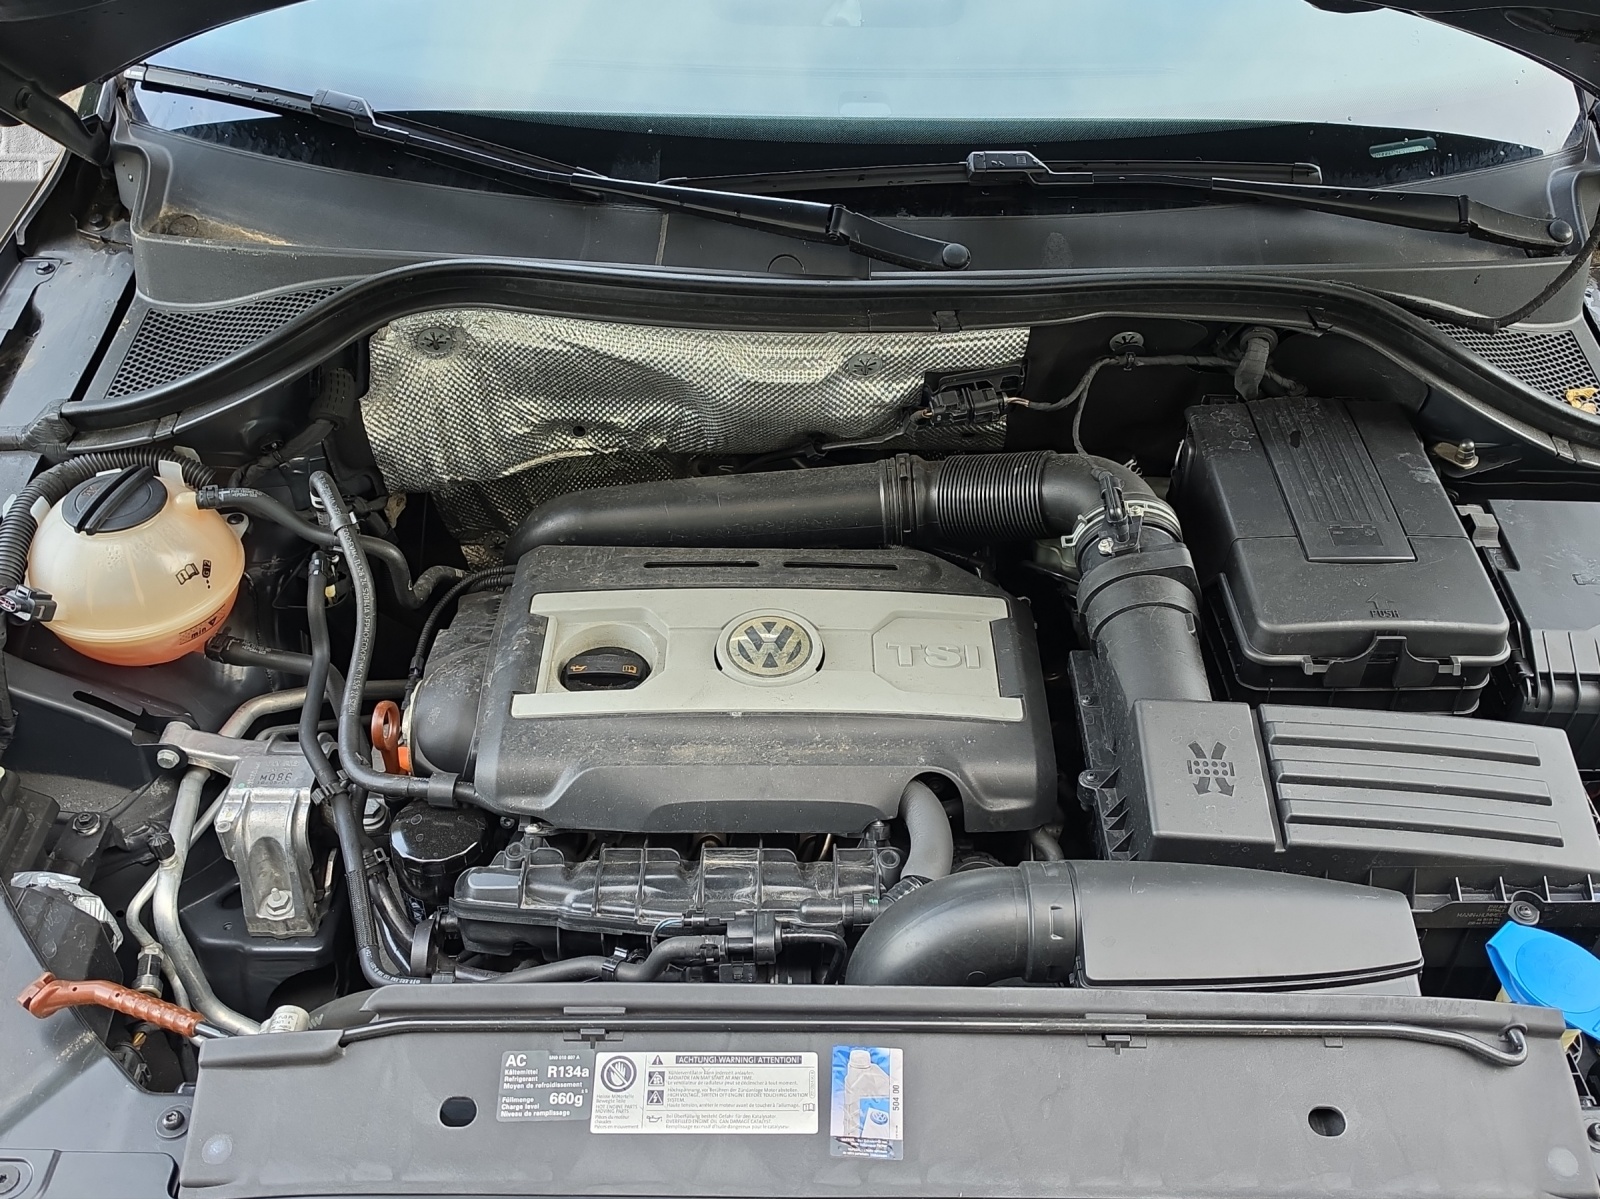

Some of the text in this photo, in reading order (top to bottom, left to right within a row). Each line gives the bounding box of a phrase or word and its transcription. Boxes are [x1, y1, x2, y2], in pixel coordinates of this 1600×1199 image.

[203, 560, 211, 578] G12
[1370, 609, 1400, 618] PUSH
[190, 627, 207, 639] min
[886, 642, 981, 670] TSI
[505, 1054, 527, 1067] AC
[679, 1056, 800, 1064] ACHTUNG! WARNING! ATTENTION!
[547, 1065, 590, 1078] R134a
[892, 1084, 900, 1094] 00
[549, 1092, 584, 1108] 660g
[533, 1110, 571, 1118] remplissage
